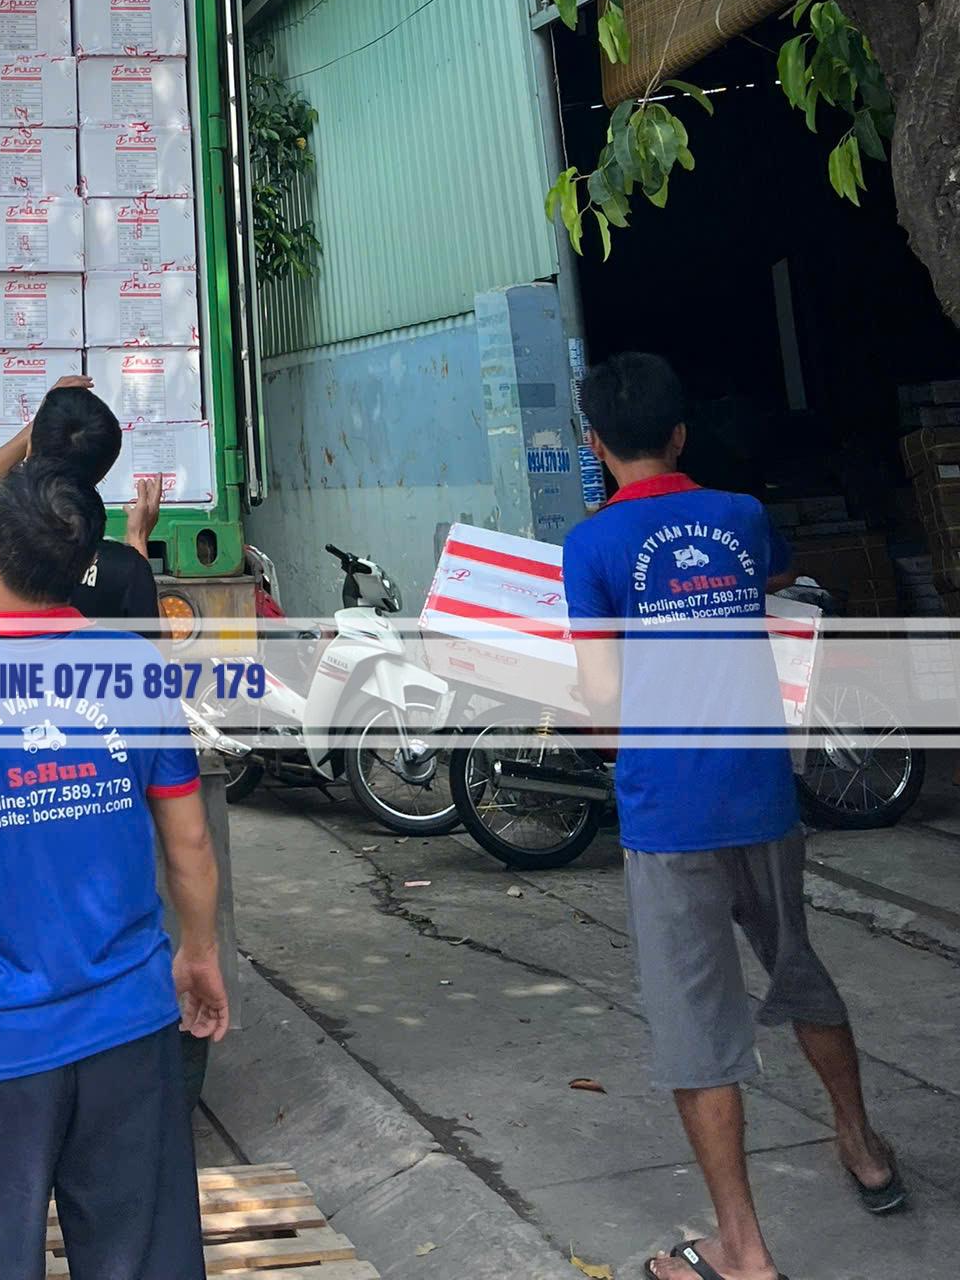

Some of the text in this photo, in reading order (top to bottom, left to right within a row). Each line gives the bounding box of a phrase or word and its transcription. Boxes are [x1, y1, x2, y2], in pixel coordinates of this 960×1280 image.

[632, 521, 756, 591] CÔNG TY VẬN TẢI BỐC XẾP
[638, 588, 759, 614] Hotline:077.589.7179
[641, 603, 760, 626] website: bocxepvn.com
[75, 698, 109, 730] BỐC
[102, 727, 128, 764] XẾP
[7, 761, 98, 788] SeHun
[33, 796, 133, 824] bocxepvn.com
